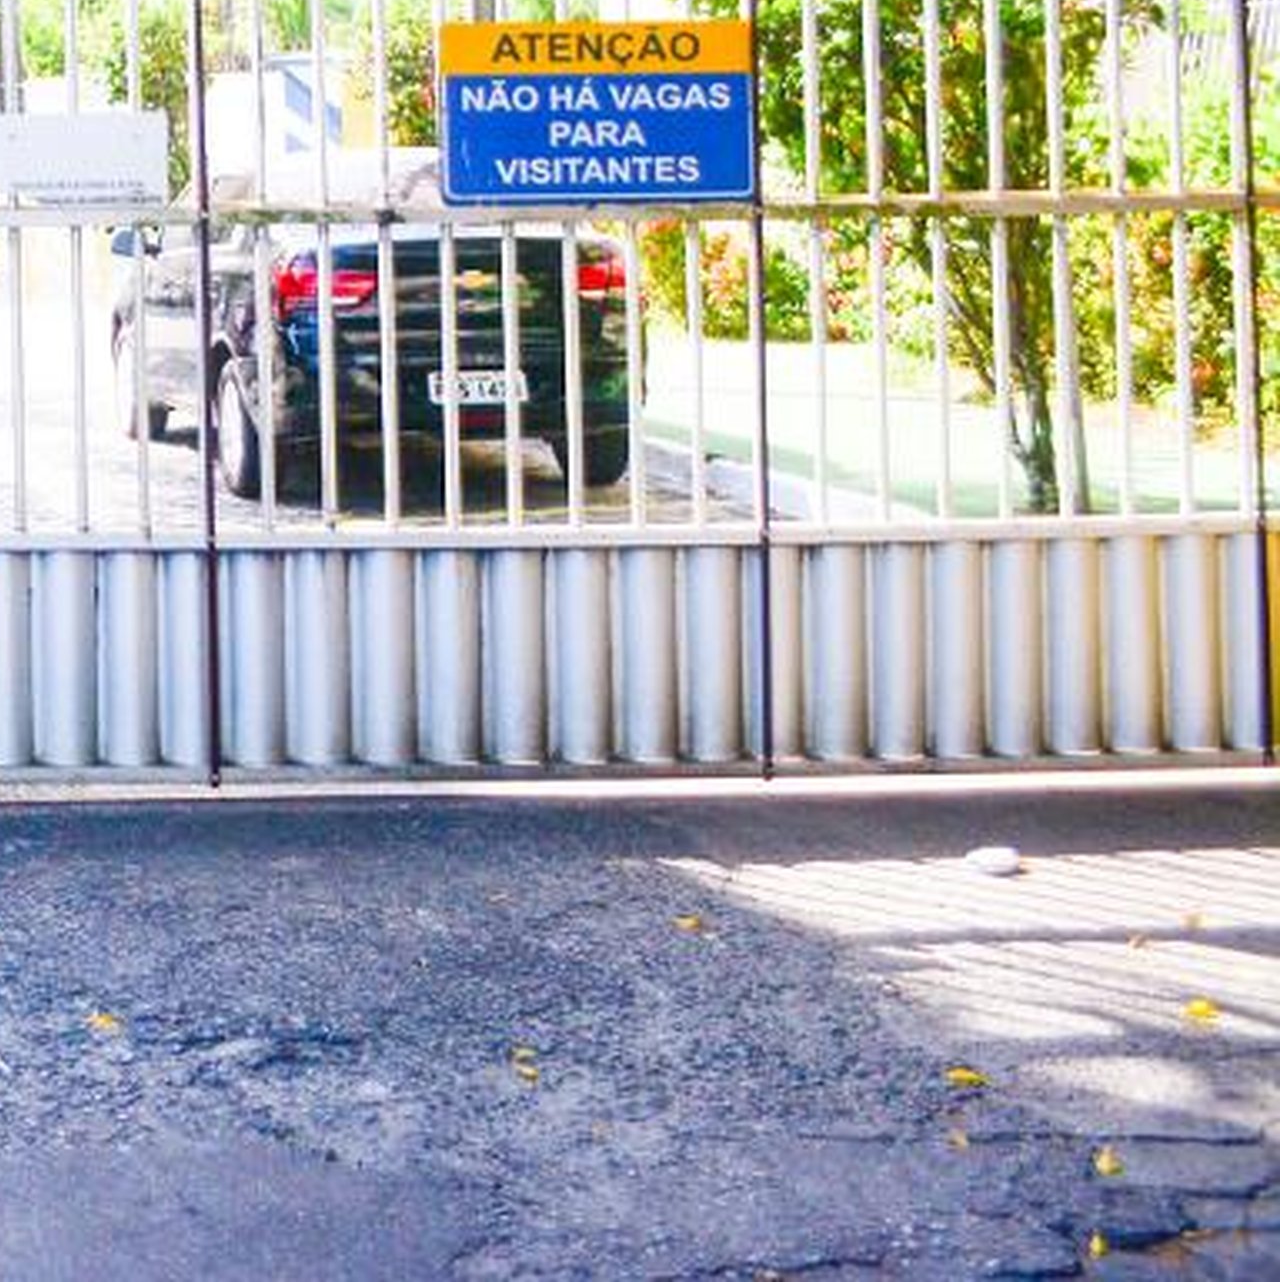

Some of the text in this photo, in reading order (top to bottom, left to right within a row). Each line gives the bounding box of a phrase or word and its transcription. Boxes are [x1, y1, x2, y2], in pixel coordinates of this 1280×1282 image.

[491, 25, 700, 67] ATENÇÃO
[460, 79, 731, 112] NÃO HÁ VAGAS
[549, 120, 646, 148] PARA
[495, 156, 700, 185] VISITANTES
